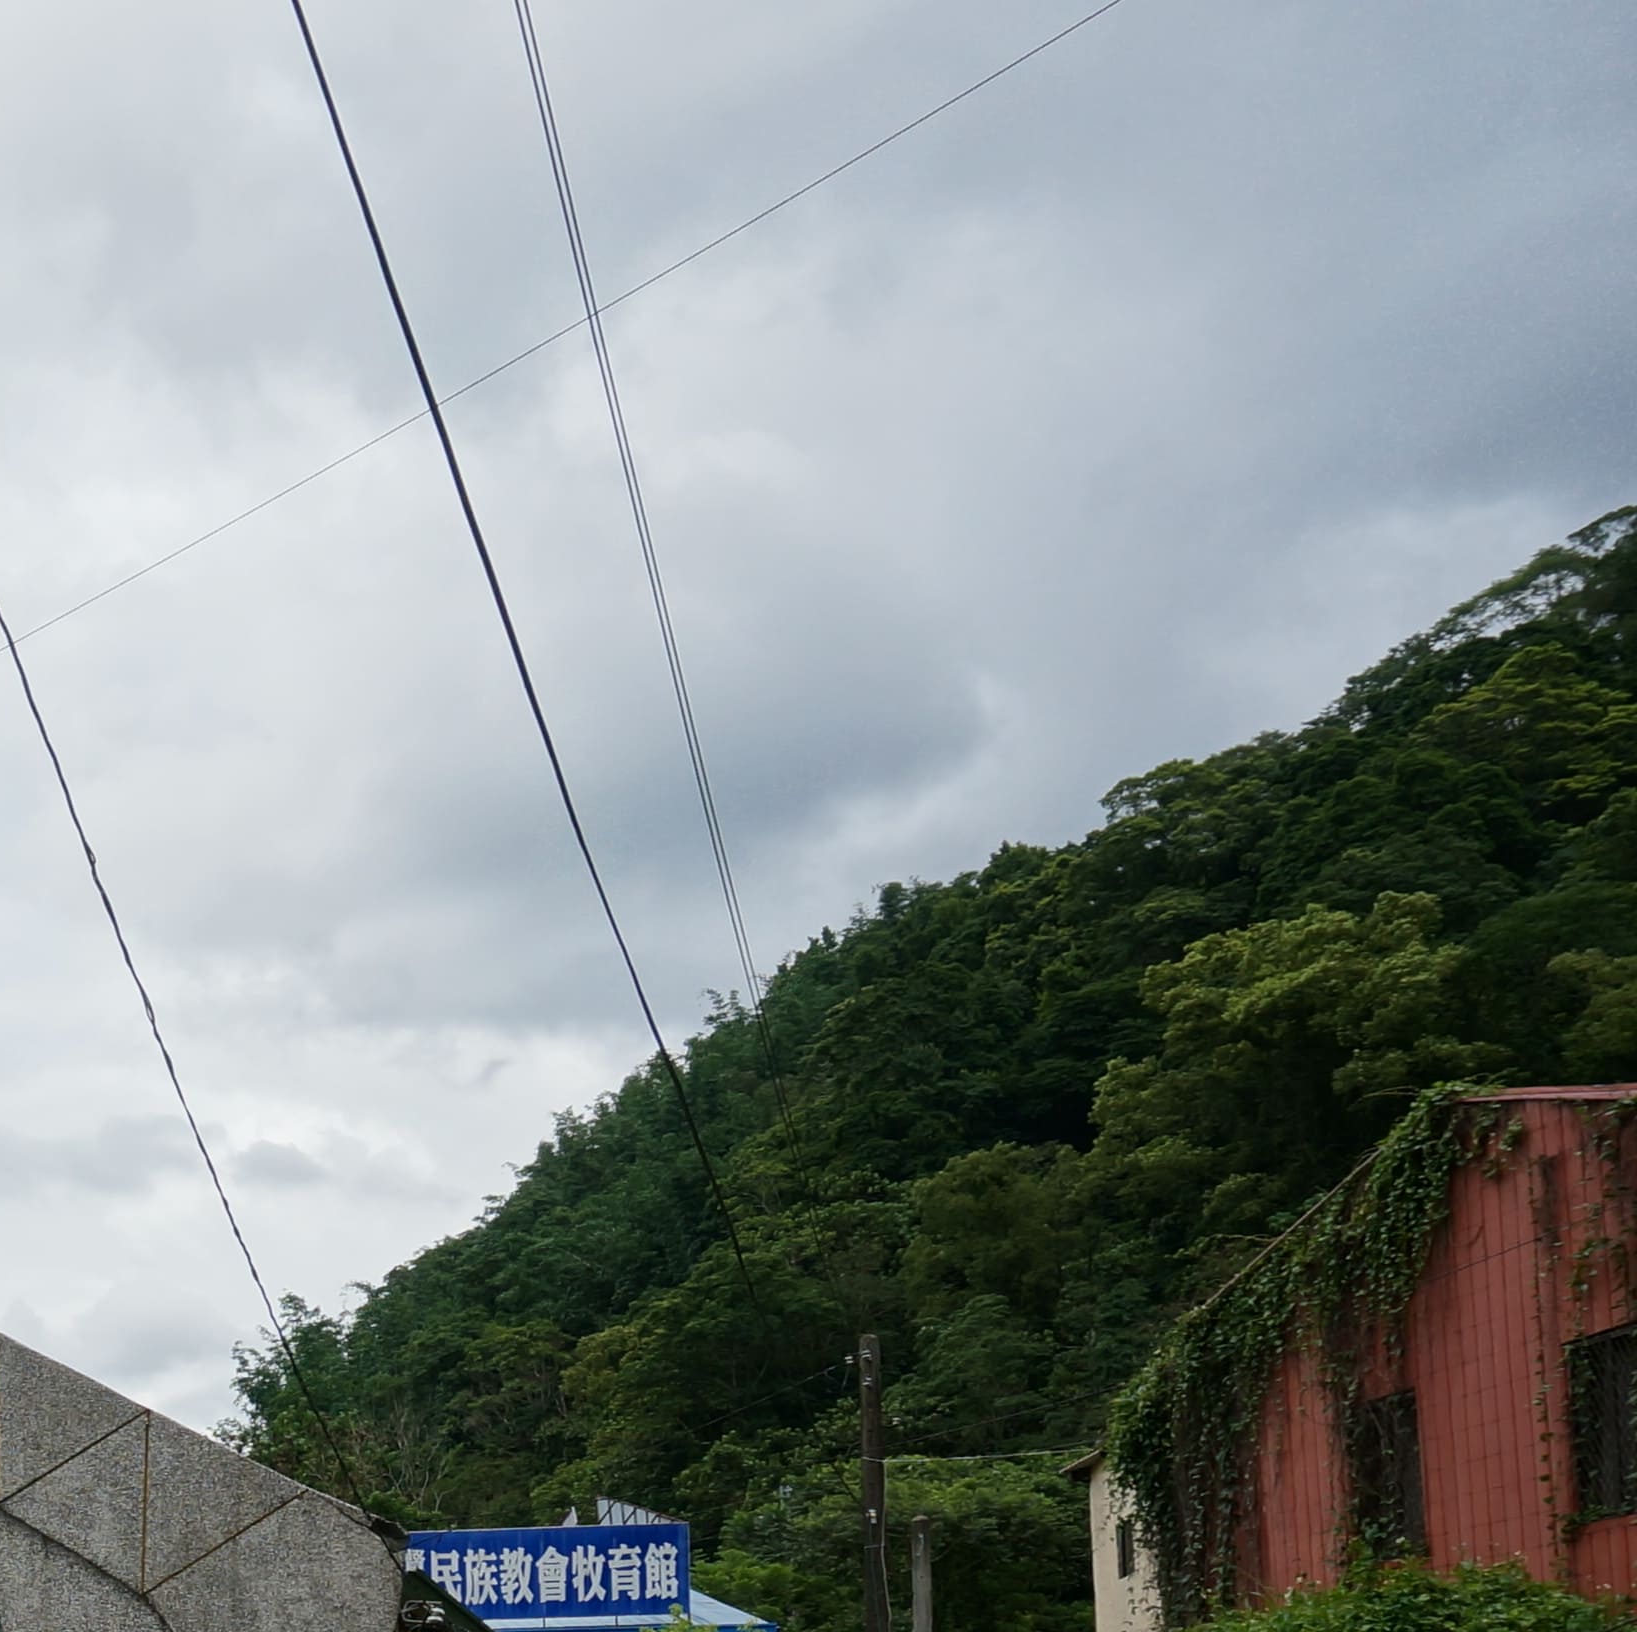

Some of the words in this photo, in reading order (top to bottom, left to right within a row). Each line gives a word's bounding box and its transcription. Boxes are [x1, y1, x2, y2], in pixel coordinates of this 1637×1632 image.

[430, 1542, 678, 1605] 民族教會牧育館
